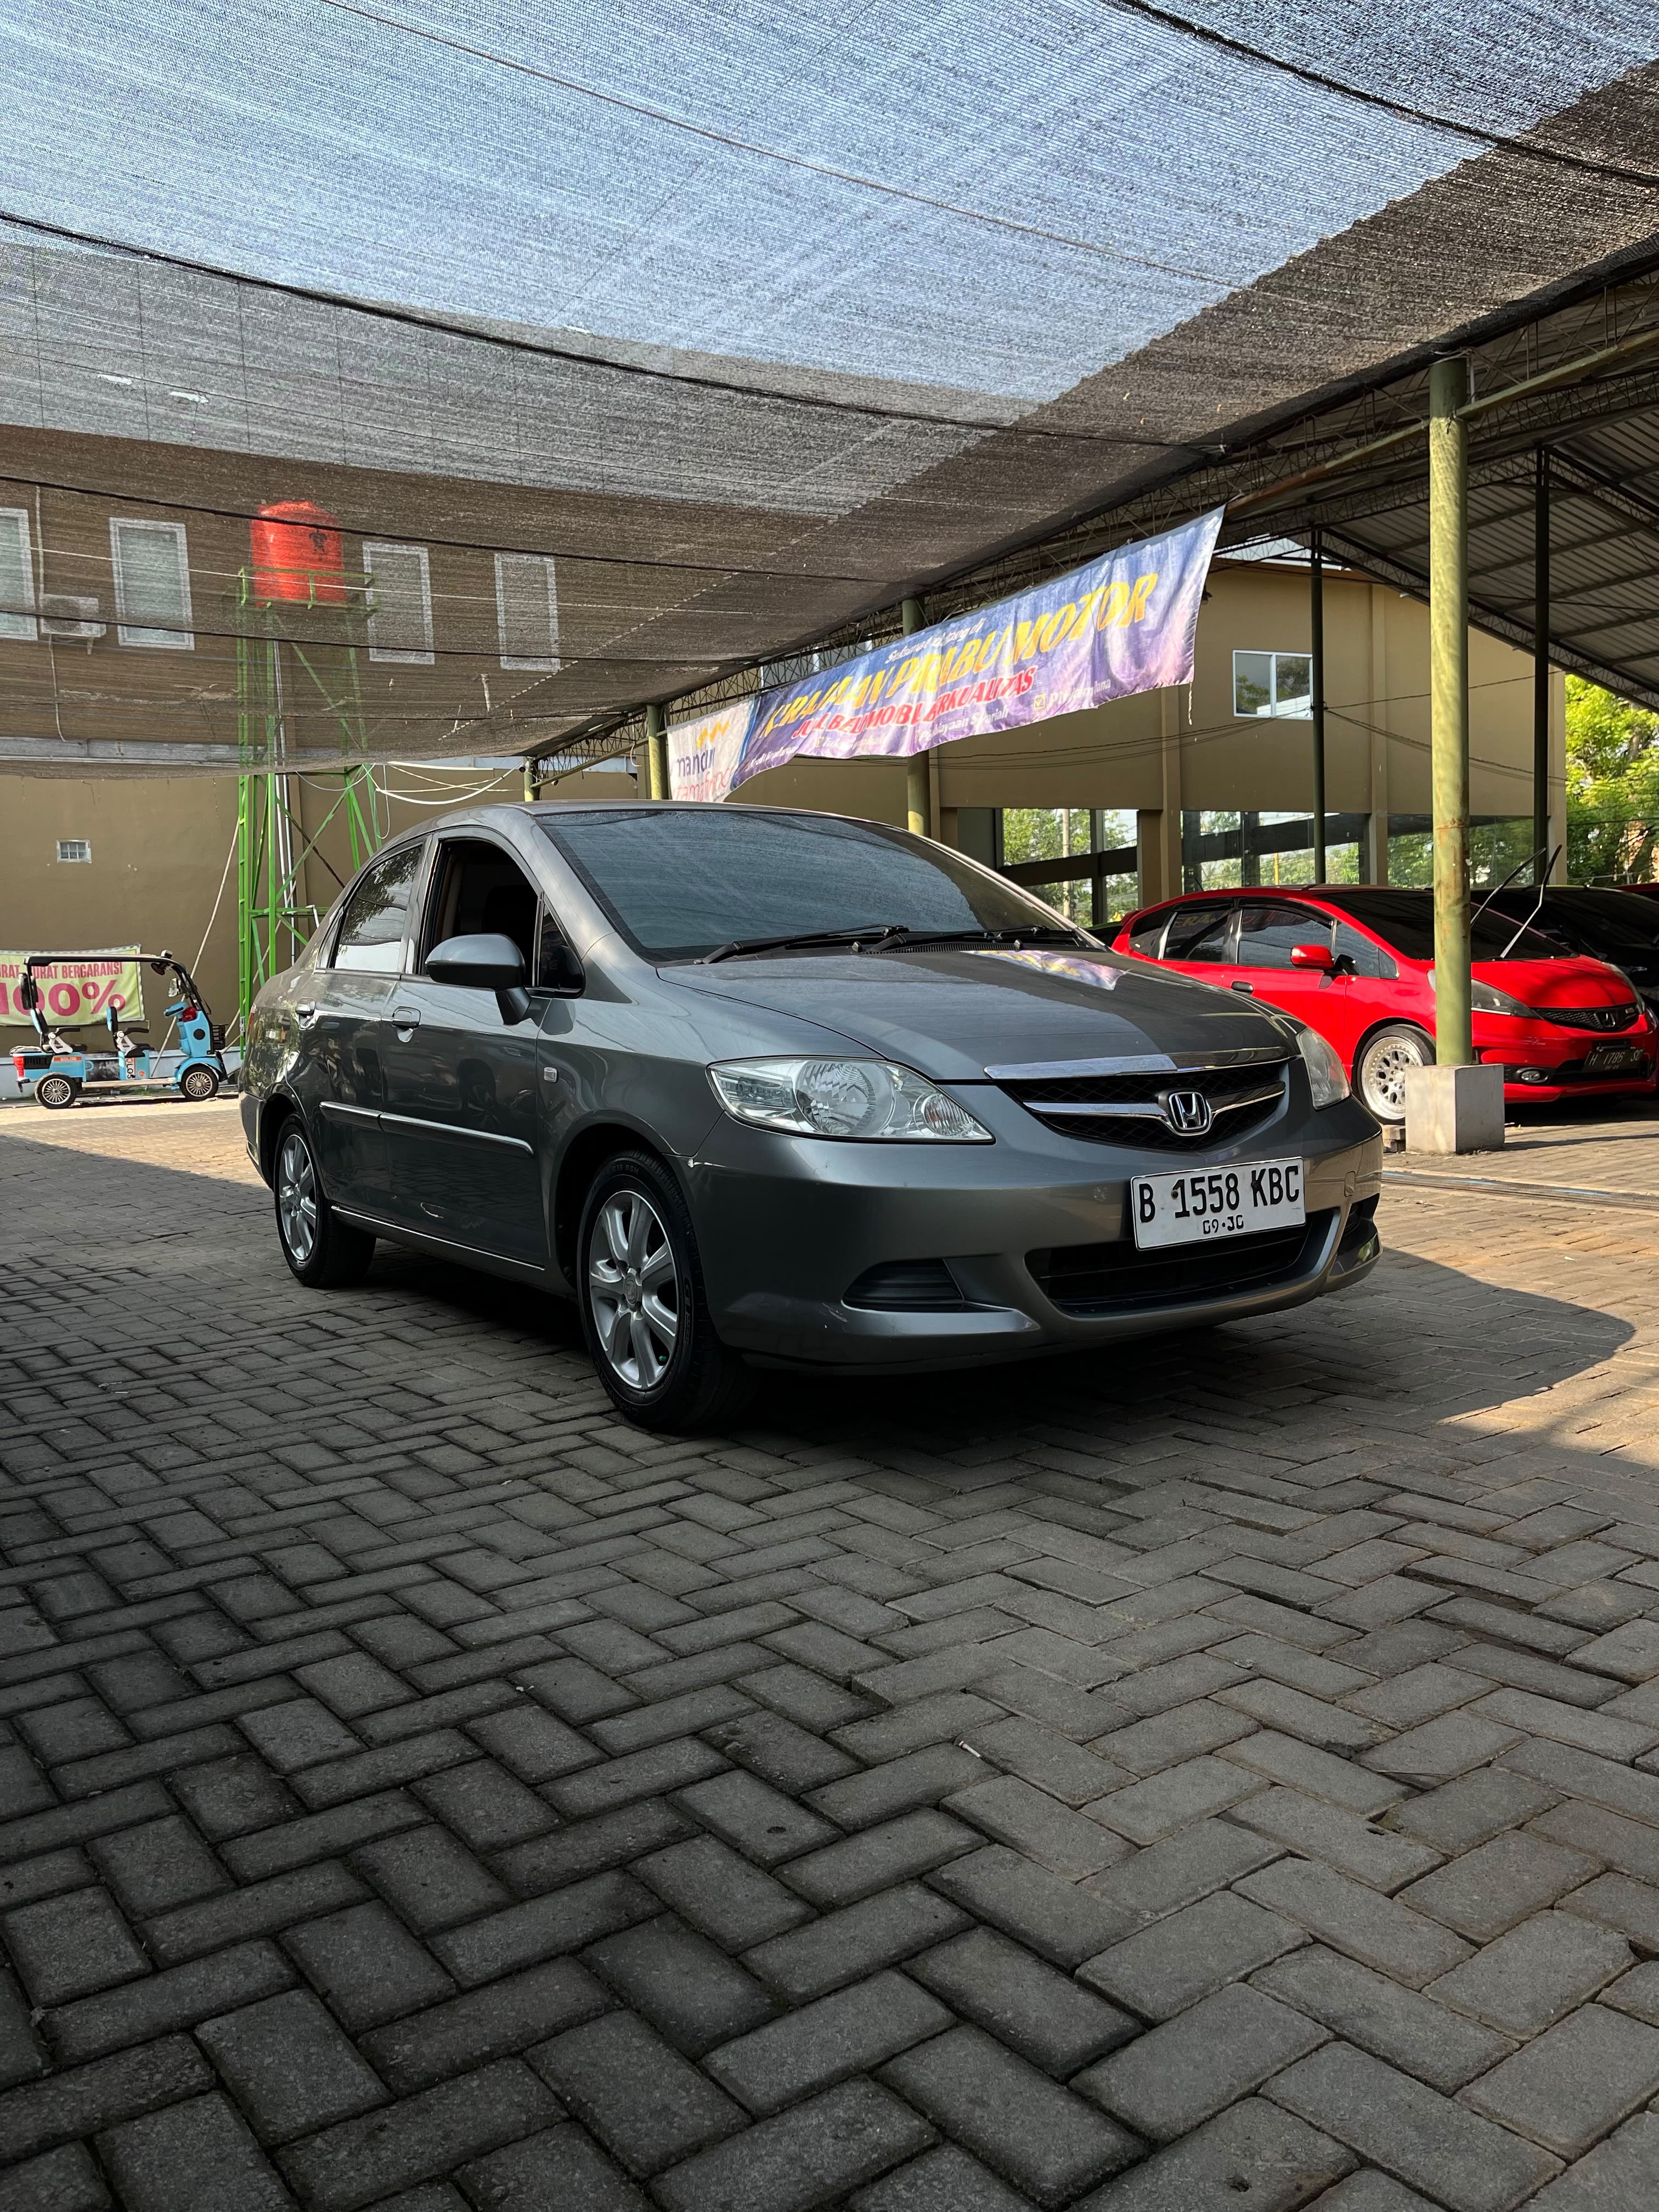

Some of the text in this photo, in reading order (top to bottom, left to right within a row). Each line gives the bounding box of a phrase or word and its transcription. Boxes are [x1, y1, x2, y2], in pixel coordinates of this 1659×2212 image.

[1013, 573, 1158, 665] MOTOR
[0, 964, 20, 979] RAT
[62, 962, 123, 979] BERGARANSI
[0, 980, 126, 1017] 100%
[1139, 1165, 1299, 1223] B 1558 KBC
